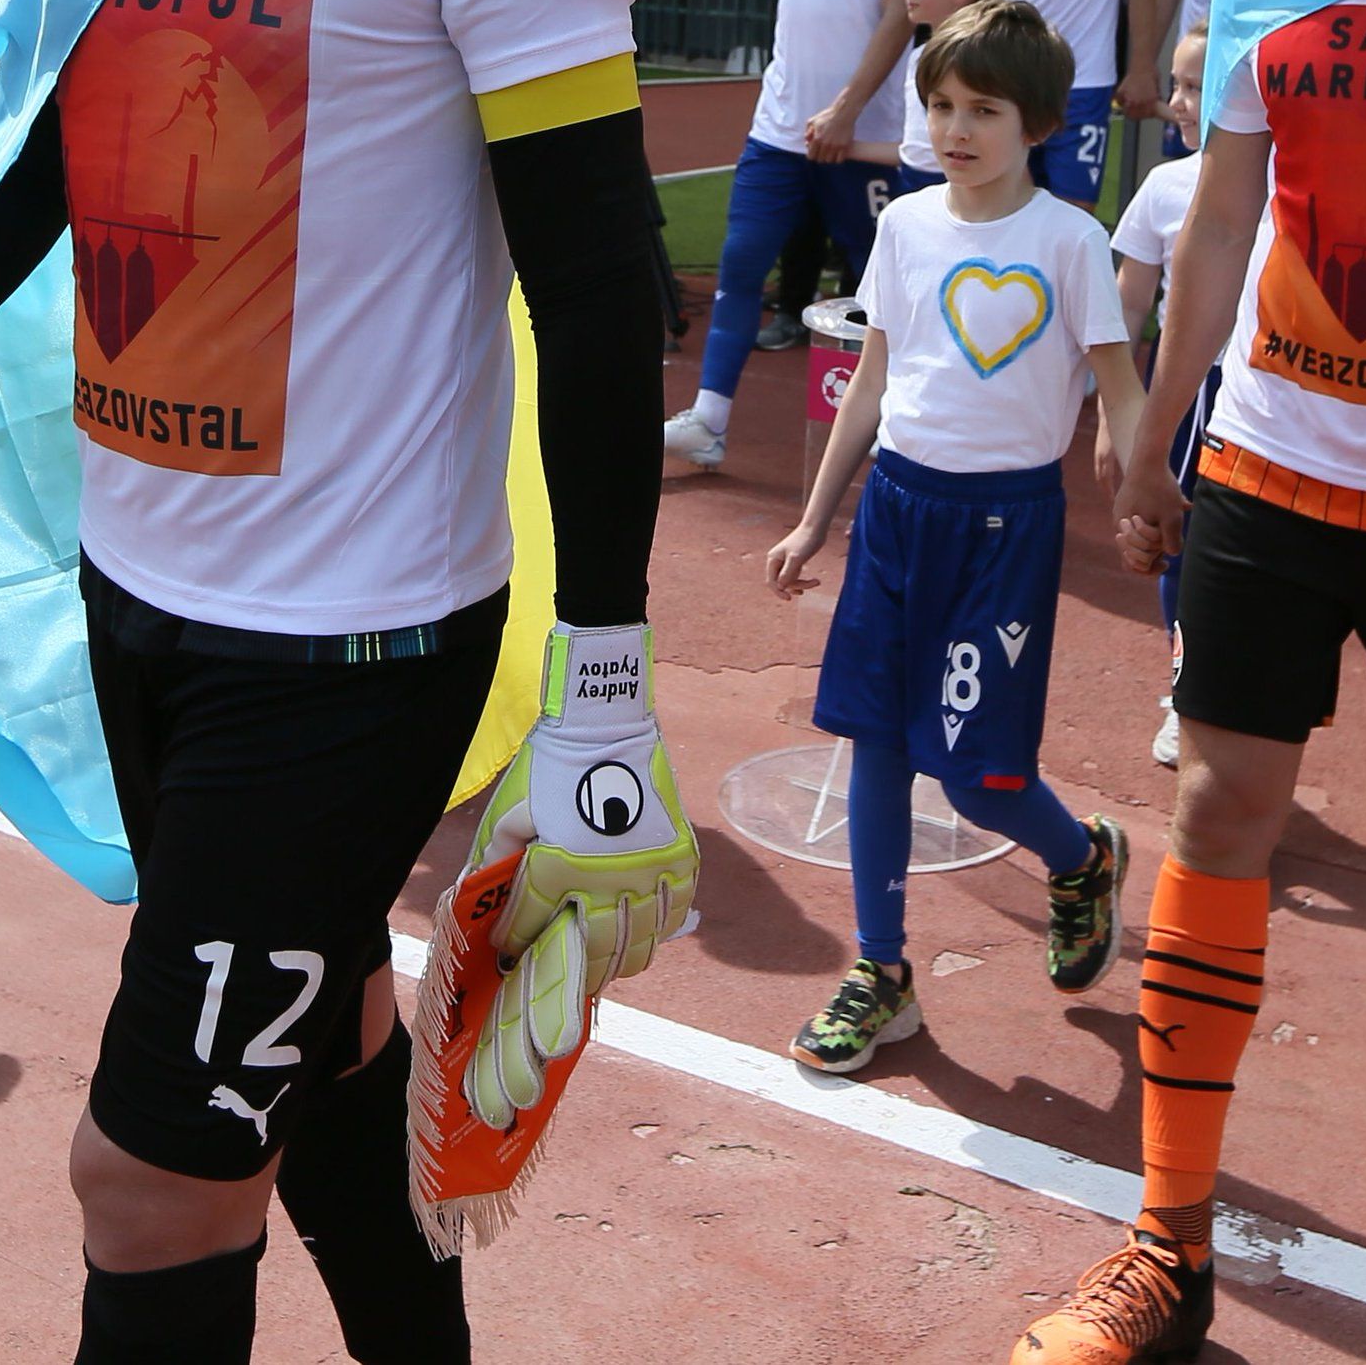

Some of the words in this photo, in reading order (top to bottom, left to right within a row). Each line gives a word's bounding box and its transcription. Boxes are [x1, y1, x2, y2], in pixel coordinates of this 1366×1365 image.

[578, 654, 639, 678] Pyatov
[577, 679, 639, 703] Andrey
[194, 940, 325, 1067] 12
